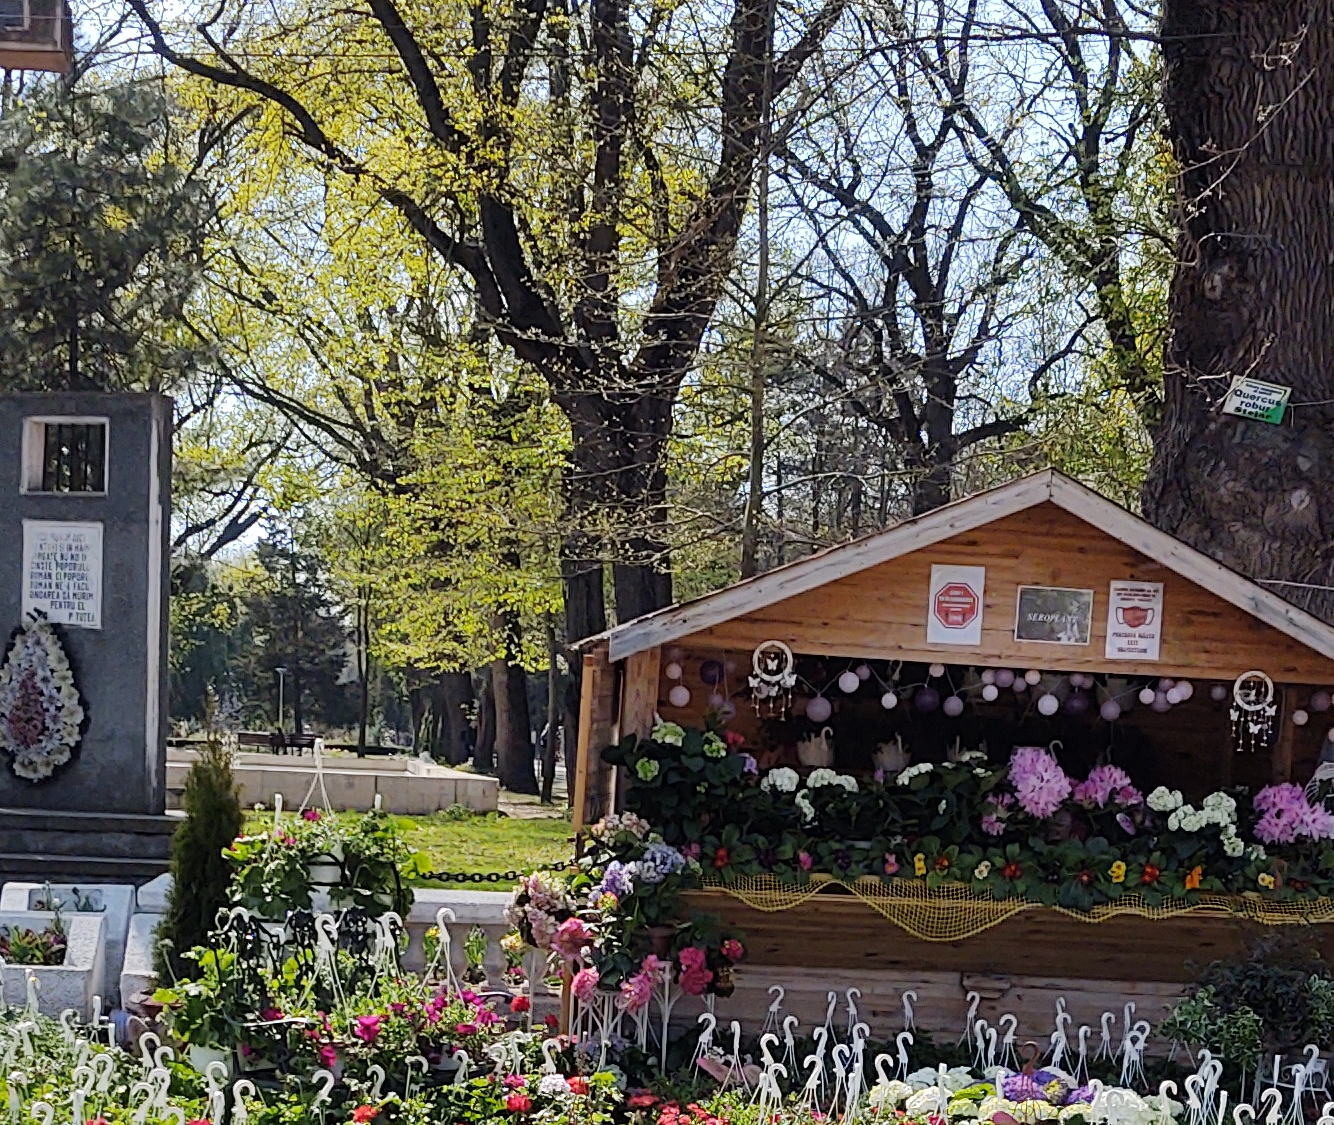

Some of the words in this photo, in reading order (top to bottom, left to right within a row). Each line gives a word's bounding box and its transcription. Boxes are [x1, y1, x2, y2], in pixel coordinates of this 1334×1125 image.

[1235, 389, 1282, 407] Quercus
[1234, 406, 1272, 419] Stejar
[1240, 400, 1270, 413] robur
[50, 600, 75, 610] PENTRU
[77, 601, 86, 611] EL
[1027, 612, 1079, 623] SEROPLANT
